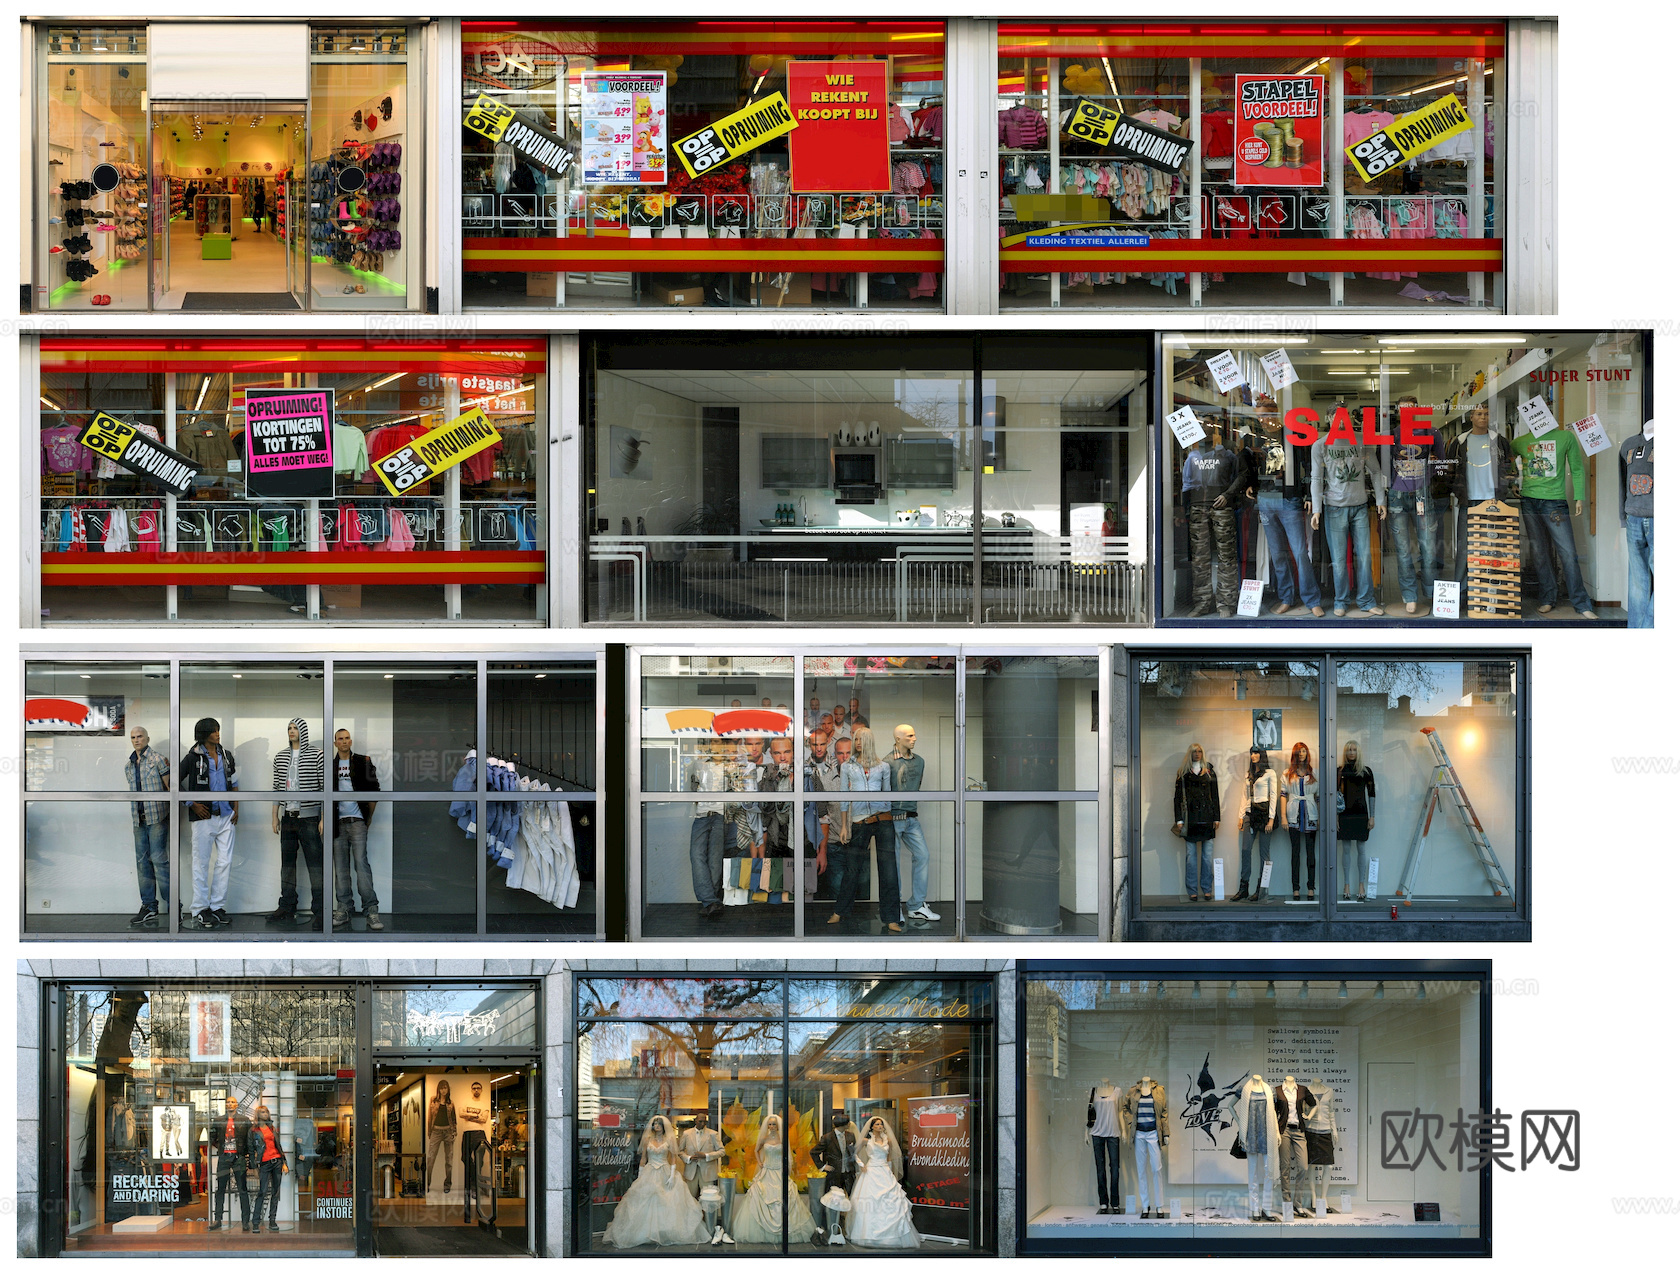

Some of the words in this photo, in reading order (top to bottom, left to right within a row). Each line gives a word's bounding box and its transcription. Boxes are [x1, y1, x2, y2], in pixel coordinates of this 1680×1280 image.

[609, 81, 660, 93] VOORDEEL!
[825, 75, 854, 86] WIE
[1241, 78, 1318, 101] STAPEL
[811, 91, 869, 103] REKENT
[478, 98, 512, 118] OP
[798, 108, 851, 120] KOOPT
[855, 108, 879, 120] BIJ
[1080, 104, 1117, 122] OP
[1242, 99, 1318, 120] VOORDEEL!
[468, 115, 501, 136] OP
[721, 100, 792, 149] OPRUIMING
[1072, 122, 1109, 141] OP
[1394, 102, 1466, 152] OPRUIMING
[505, 121, 574, 174] OPRUIMING
[682, 129, 715, 154] OP
[1113, 122, 1188, 169] OPRUIMING
[1354, 133, 1387, 158] OP
[694, 147, 726, 171] OP
[1367, 149, 1400, 175] OP
[1586, 369, 1632, 382] STUNT
[248, 397, 323, 418] OPRUIMING!
[1529, 401, 1537, 409] X
[97, 416, 133, 437] OP
[1170, 415, 1177, 423] 3
[1177, 411, 1185, 419] X
[1284, 407, 1435, 446] SALE
[1575, 416, 1595, 427] SUPER
[252, 417, 323, 438] KORTINGEN
[1578, 421, 1597, 433] STUNT
[86, 434, 122, 454] OP
[262, 436, 287, 453] TOT
[290, 434, 316, 451] 75%
[420, 415, 494, 466] OPRUIMING
[125, 439, 198, 491] OPRUIMING
[254, 457, 280, 469] ALLES
[281, 455, 305, 467] MOET
[306, 453, 329, 464] WEG!
[382, 448, 413, 473] OP
[394, 464, 428, 489] OP
[1303, 1028, 1340, 1036] symbolize
[1186, 1109, 1221, 1128] LOVE
[911, 1130, 970, 1148] Bruidsmode
[112, 1174, 180, 1189] RECKLESS
[317, 1180, 353, 1198] SALE
[926, 1176, 961, 1190] ETAGE
[113, 1191, 132, 1200] AND
[132, 1189, 180, 1203] DARING
[316, 1197, 353, 1207] CONTINUES
[910, 1196, 946, 1206] 1000
[316, 1206, 353, 1219] INSTORE
